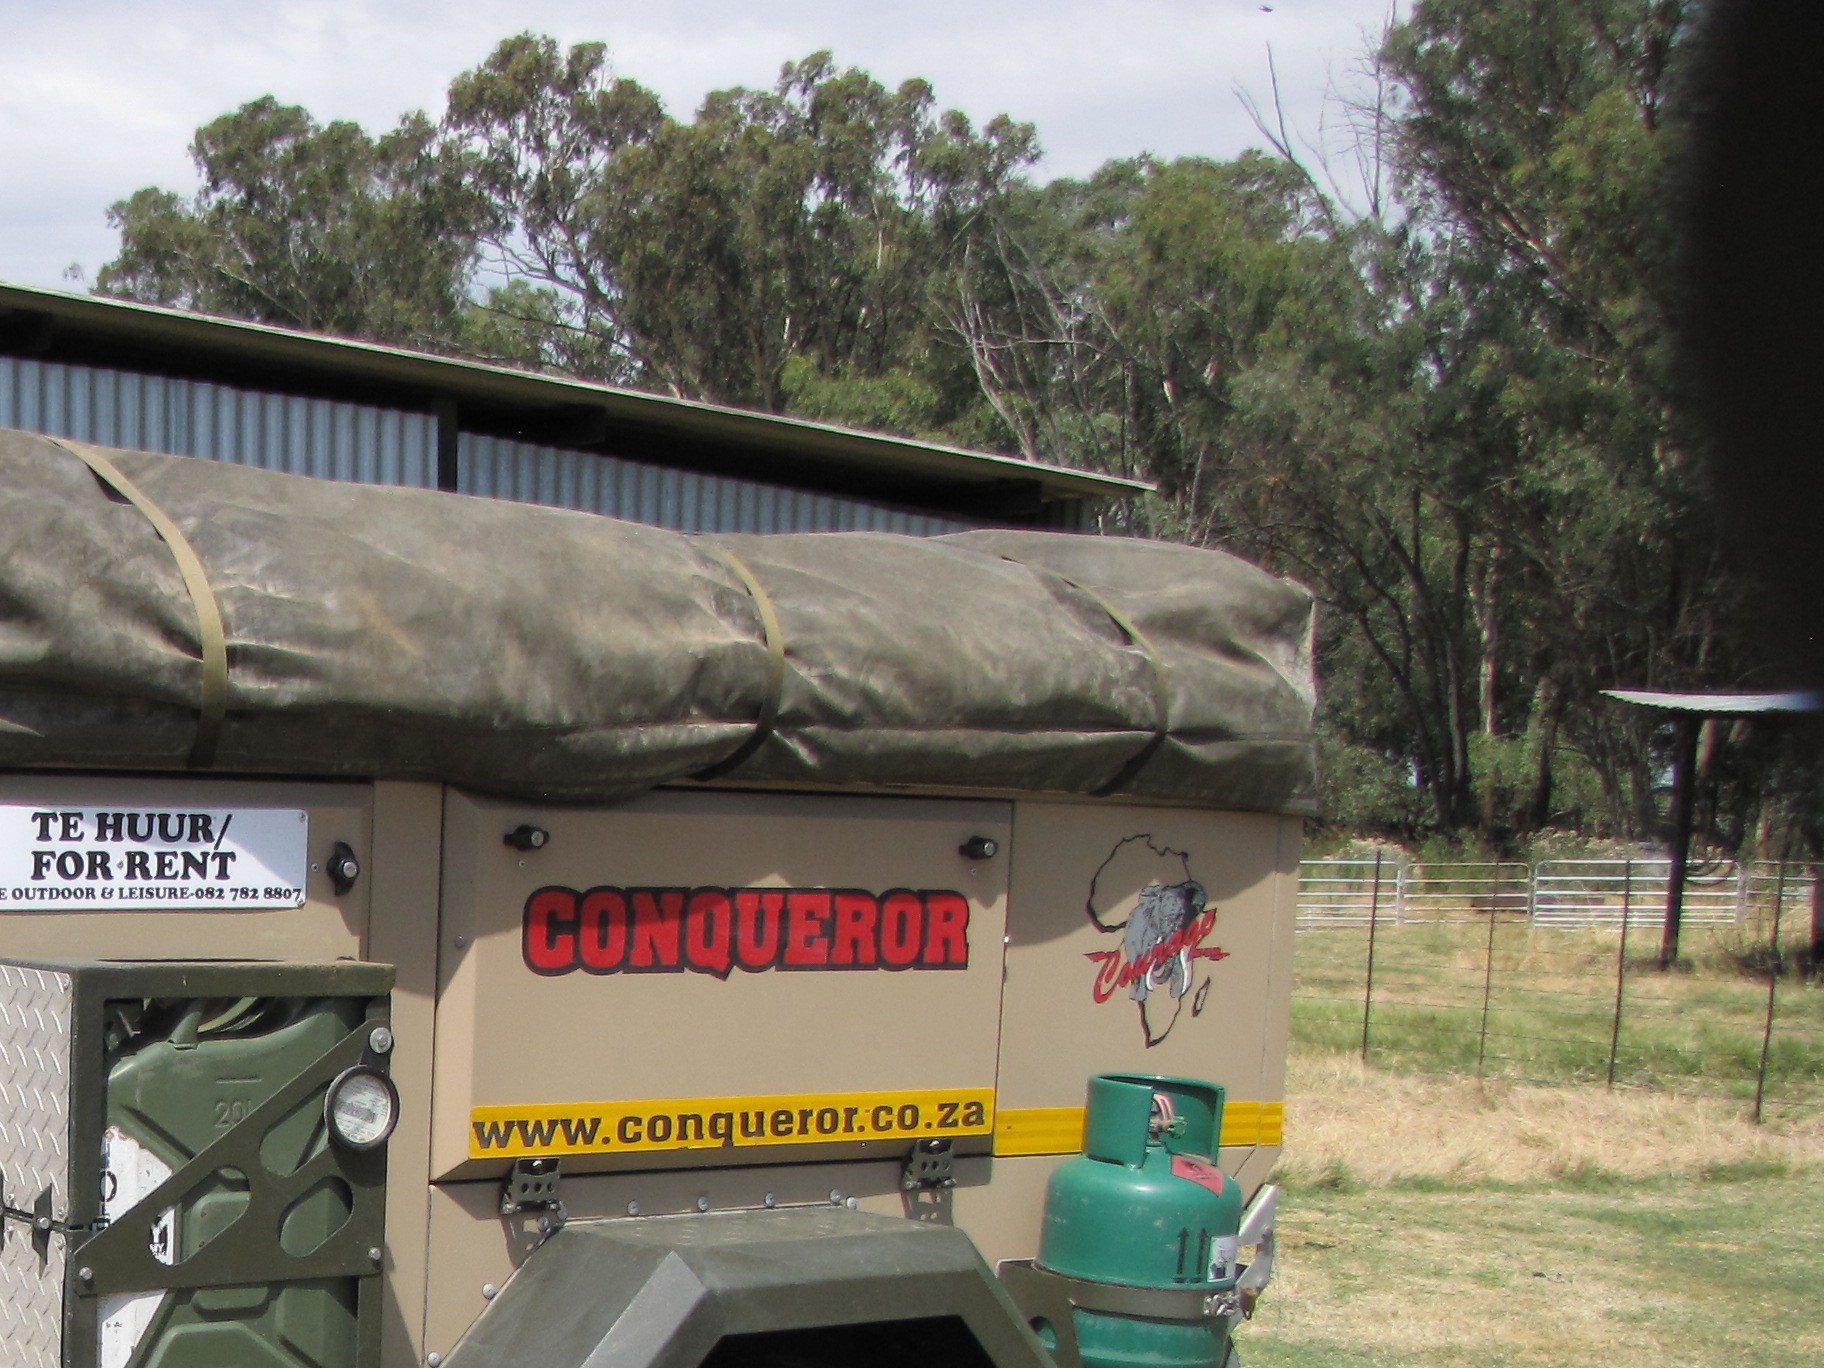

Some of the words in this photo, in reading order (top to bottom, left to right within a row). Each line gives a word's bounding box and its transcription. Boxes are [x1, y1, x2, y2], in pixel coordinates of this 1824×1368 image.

[31, 811, 85, 842] TE
[94, 812, 233, 851] HUUR/
[30, 850, 114, 881] FOR
[124, 850, 237, 881] RENT
[11, 886, 97, 900] OUTDOOR
[100, 886, 114, 900] &
[229, 887, 259, 901] 782
[263, 887, 301, 902] 8807
[522, 885, 970, 982] CONQUEROR
[472, 1100, 985, 1148] www.conqueror.co.za
